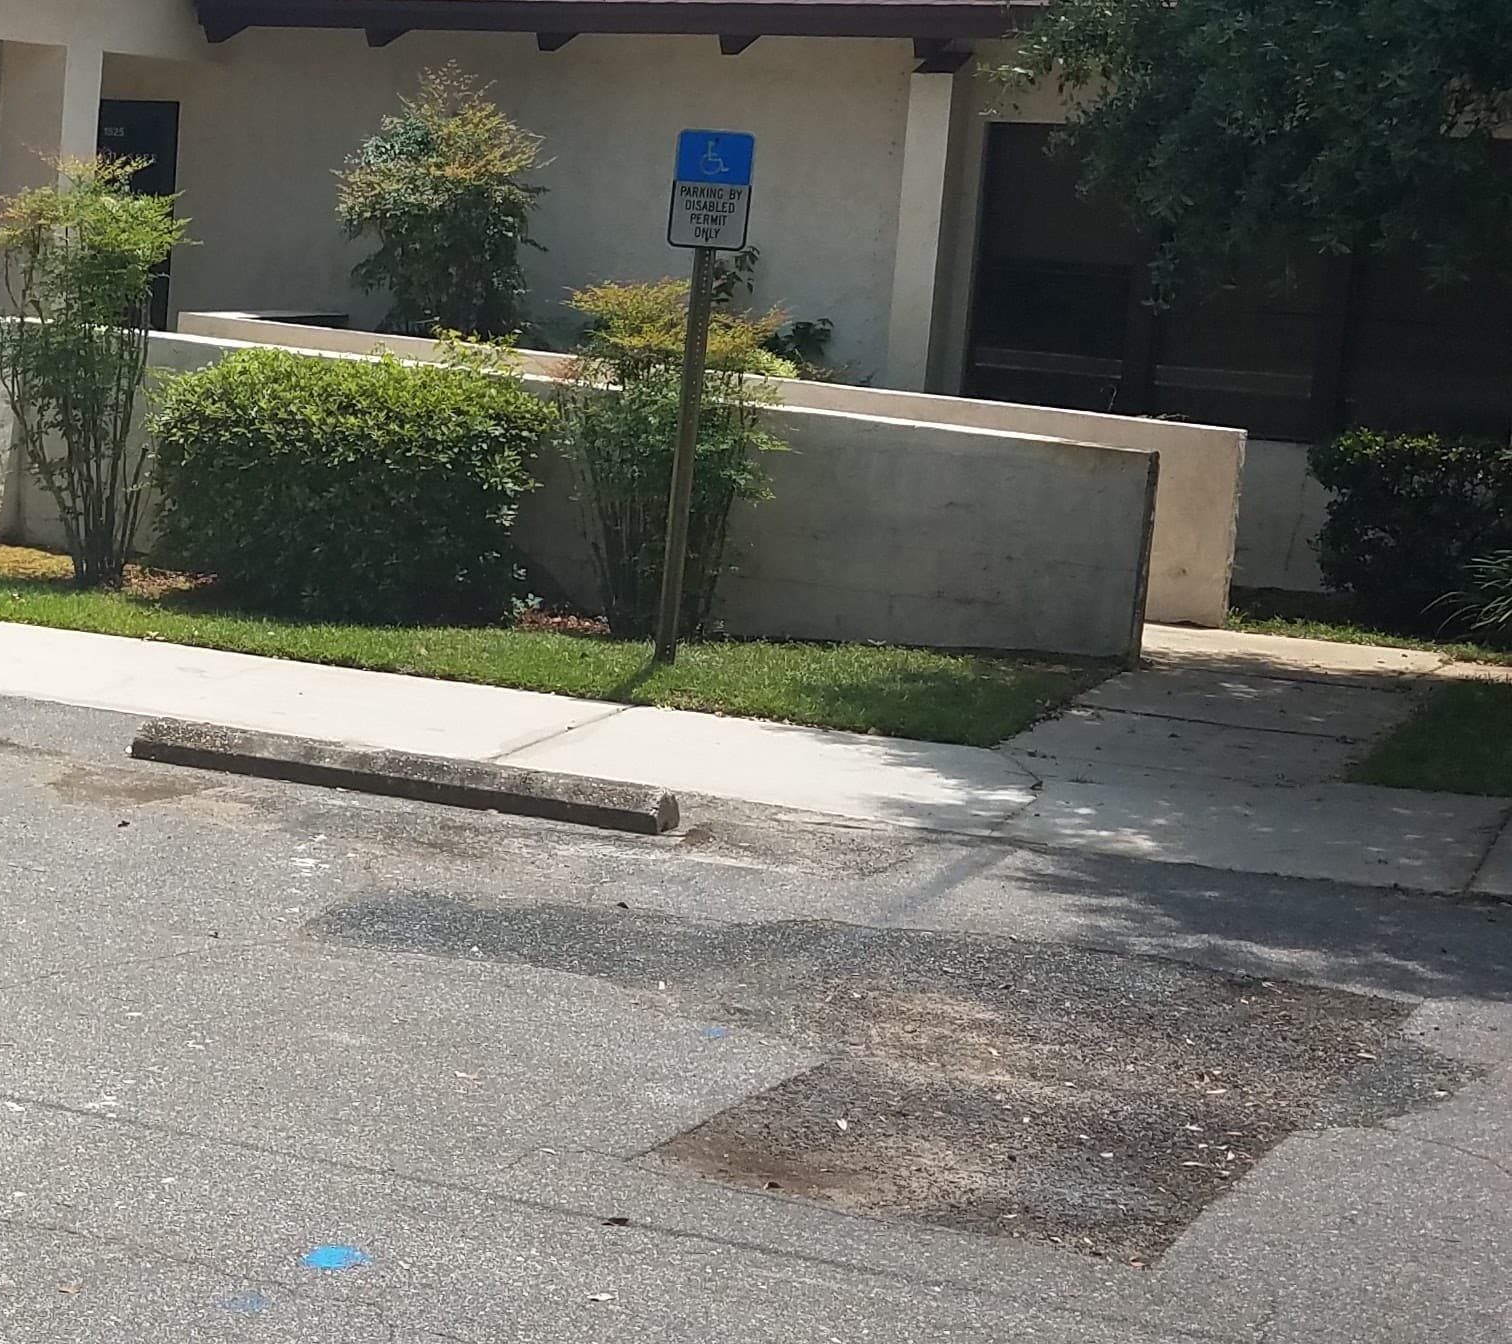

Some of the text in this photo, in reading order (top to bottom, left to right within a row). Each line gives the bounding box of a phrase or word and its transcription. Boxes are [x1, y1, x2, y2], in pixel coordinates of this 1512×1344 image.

[103, 127, 125, 137] 1525
[680, 186, 742, 200] PARKING BY
[685, 200, 735, 213] DISABLED
[690, 214, 727, 226] PERMIT
[694, 227, 720, 239] ONLY
